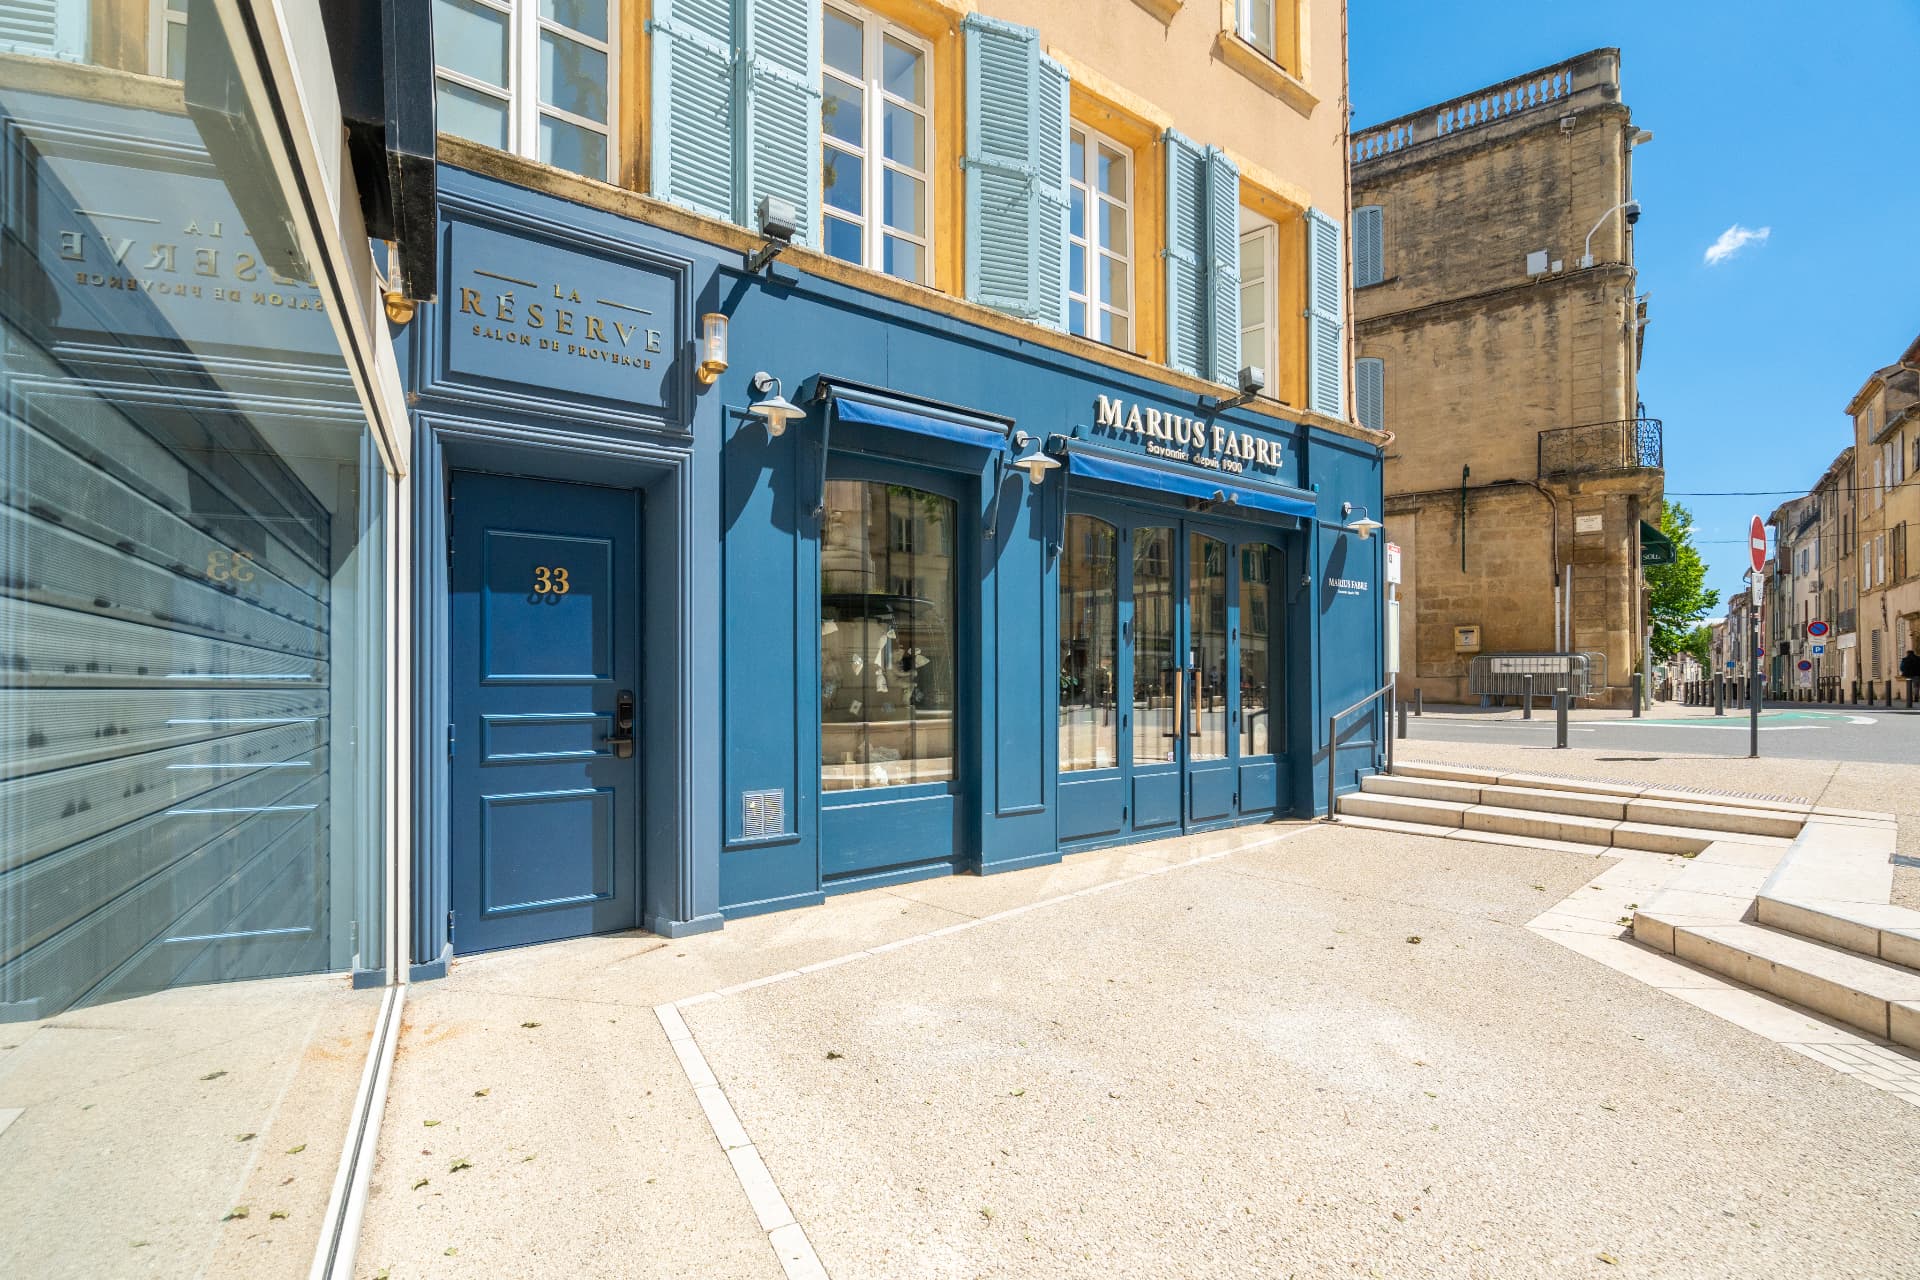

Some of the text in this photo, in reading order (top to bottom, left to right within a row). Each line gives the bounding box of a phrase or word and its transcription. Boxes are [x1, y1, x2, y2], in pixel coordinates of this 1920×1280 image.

[554, 283, 581, 303] LA
[460, 287, 662, 353] RÉSERVE
[473, 324, 652, 370] SALON DE PROVENCE
[1097, 394, 1283, 468] MARIUS FABRE
[1147, 440, 1243, 474] Savonnier depuis 1900
[534, 566, 570, 594] 33
[1328, 577, 1368, 591] MARIUS FABRE
